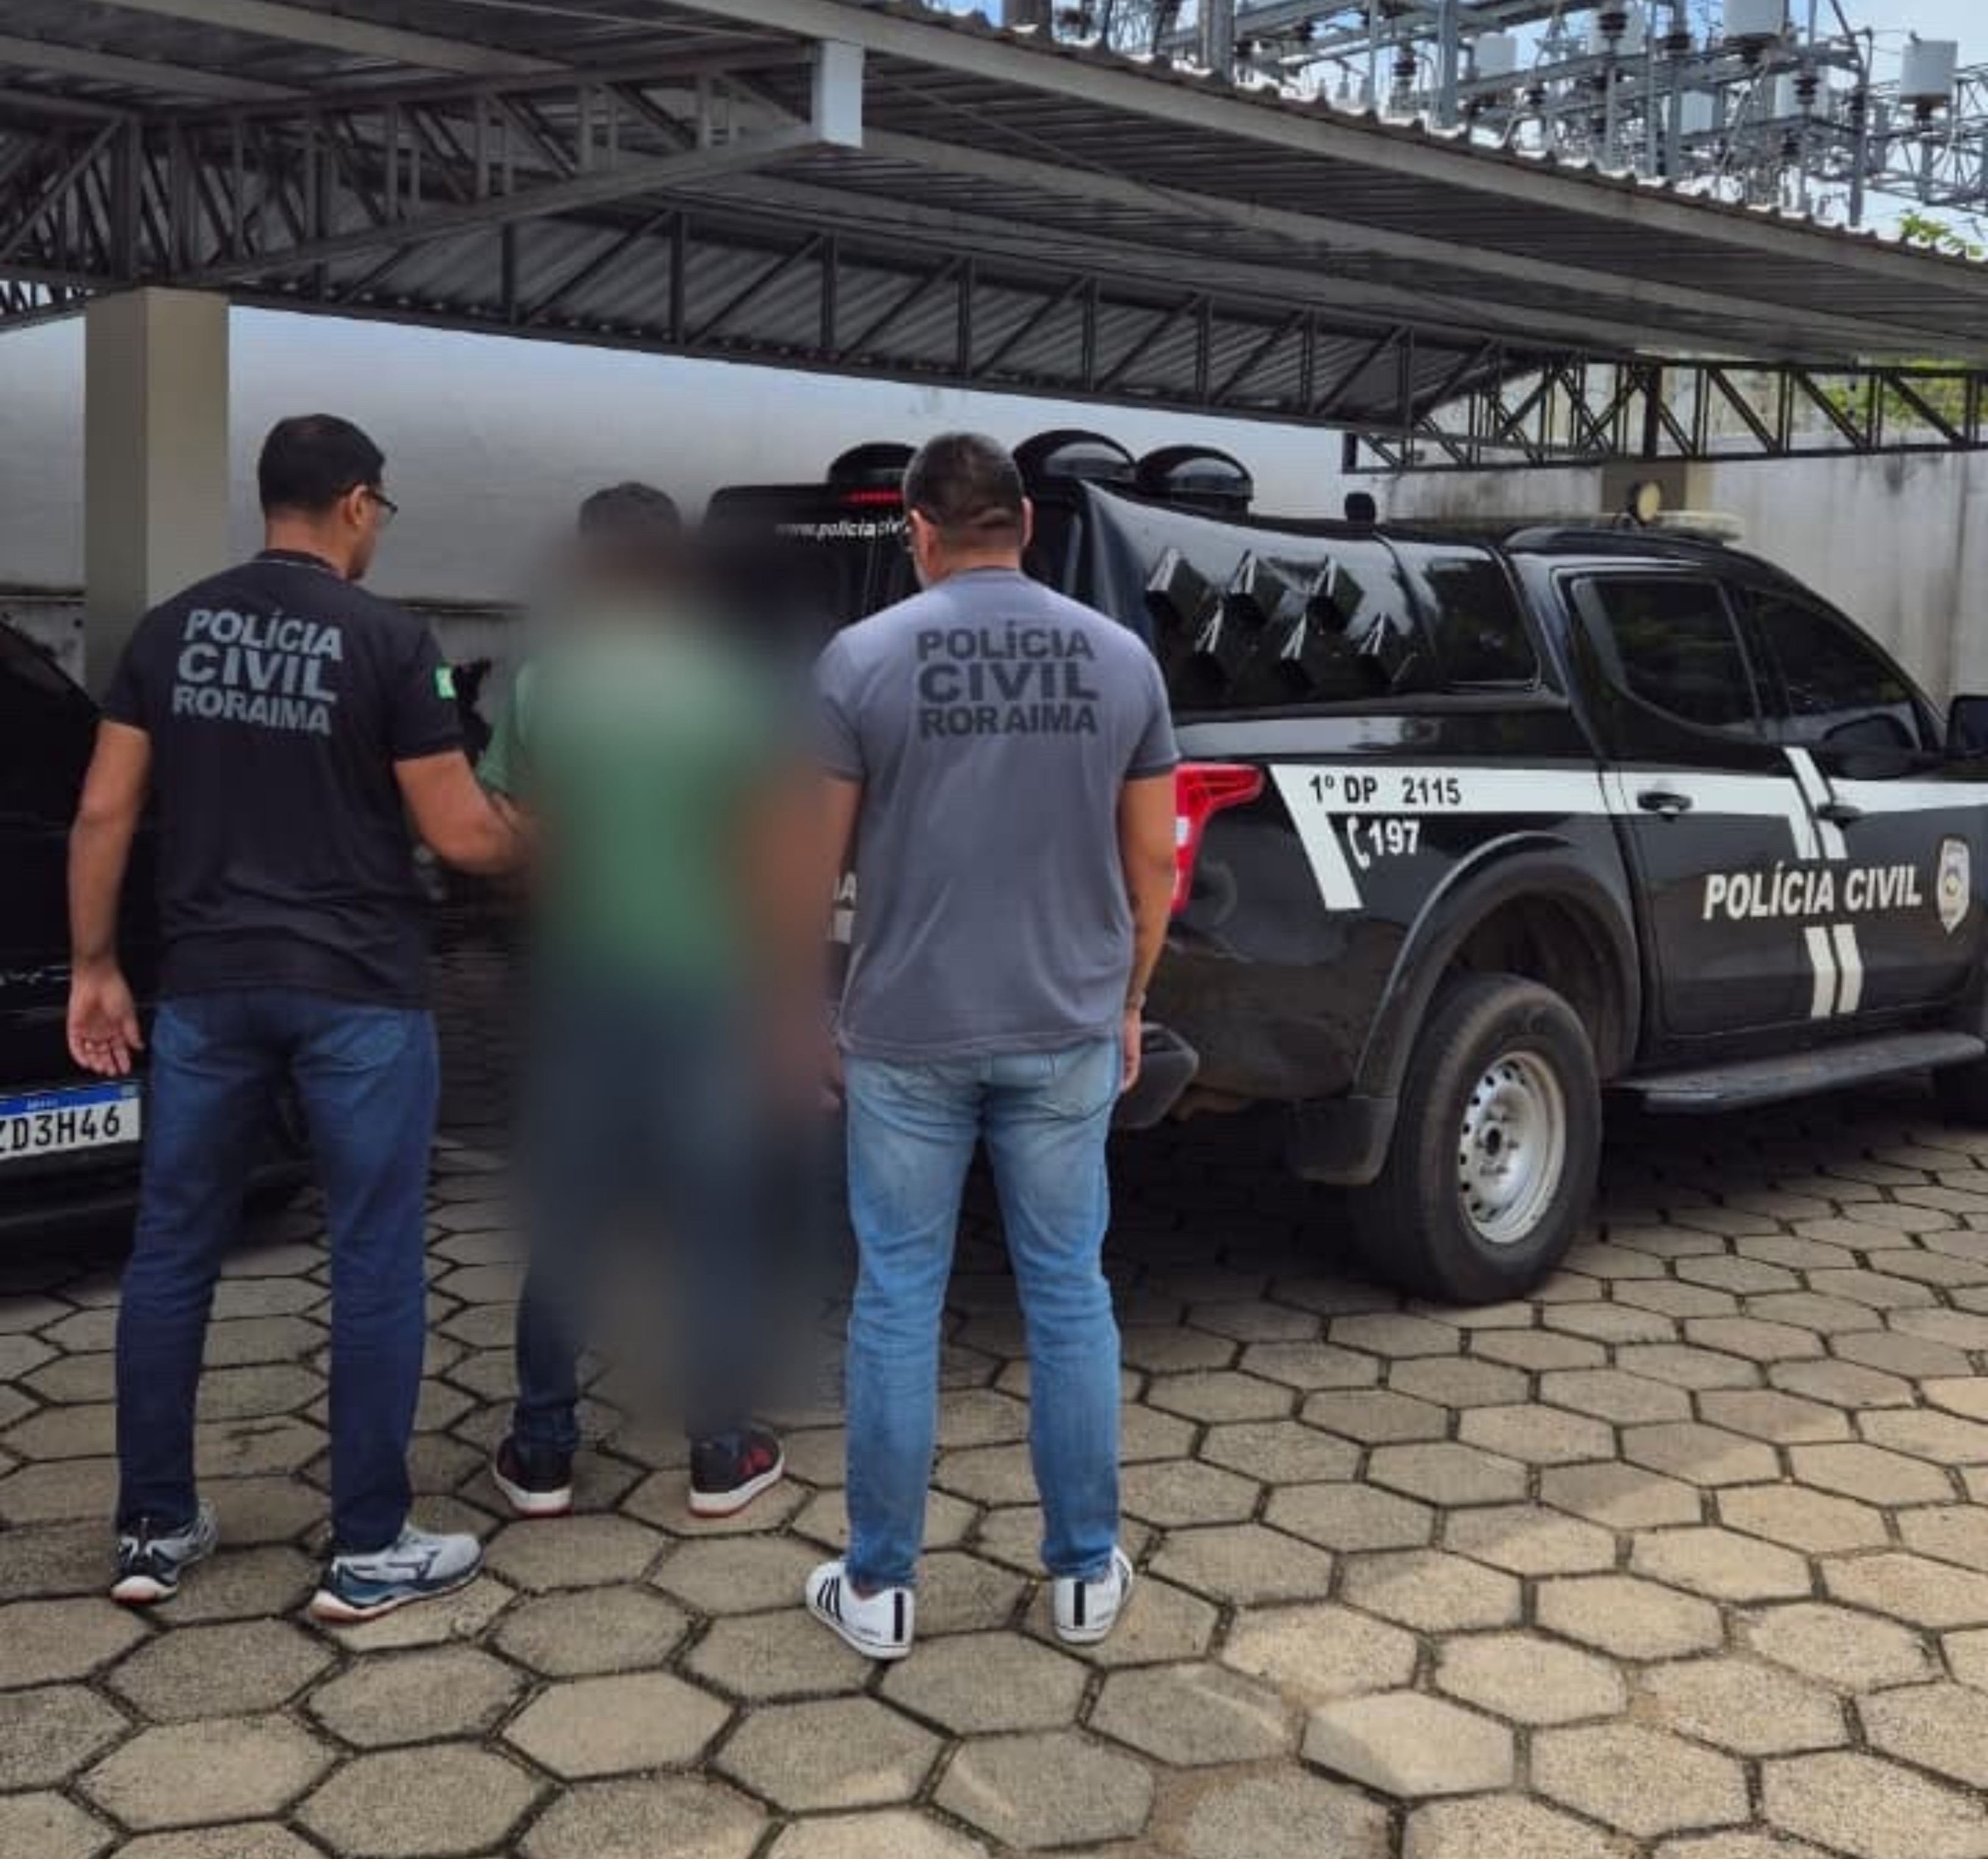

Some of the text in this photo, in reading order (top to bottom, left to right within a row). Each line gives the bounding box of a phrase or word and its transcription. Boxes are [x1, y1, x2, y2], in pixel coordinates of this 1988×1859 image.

[184, 609, 343, 661] POLÍCIA
[917, 619, 1094, 660] POLÍCIA
[178, 642, 337, 703] CIVIL
[919, 661, 1098, 702] CIVIL
[173, 686, 331, 735] RORAIMA
[918, 704, 1096, 739] RORAIMA
[1344, 776, 1378, 803] DP
[1403, 777, 1461, 805] 2115
[1369, 819, 1420, 856] 197
[1702, 860, 1922, 920] POLÍCIA CIVIL
